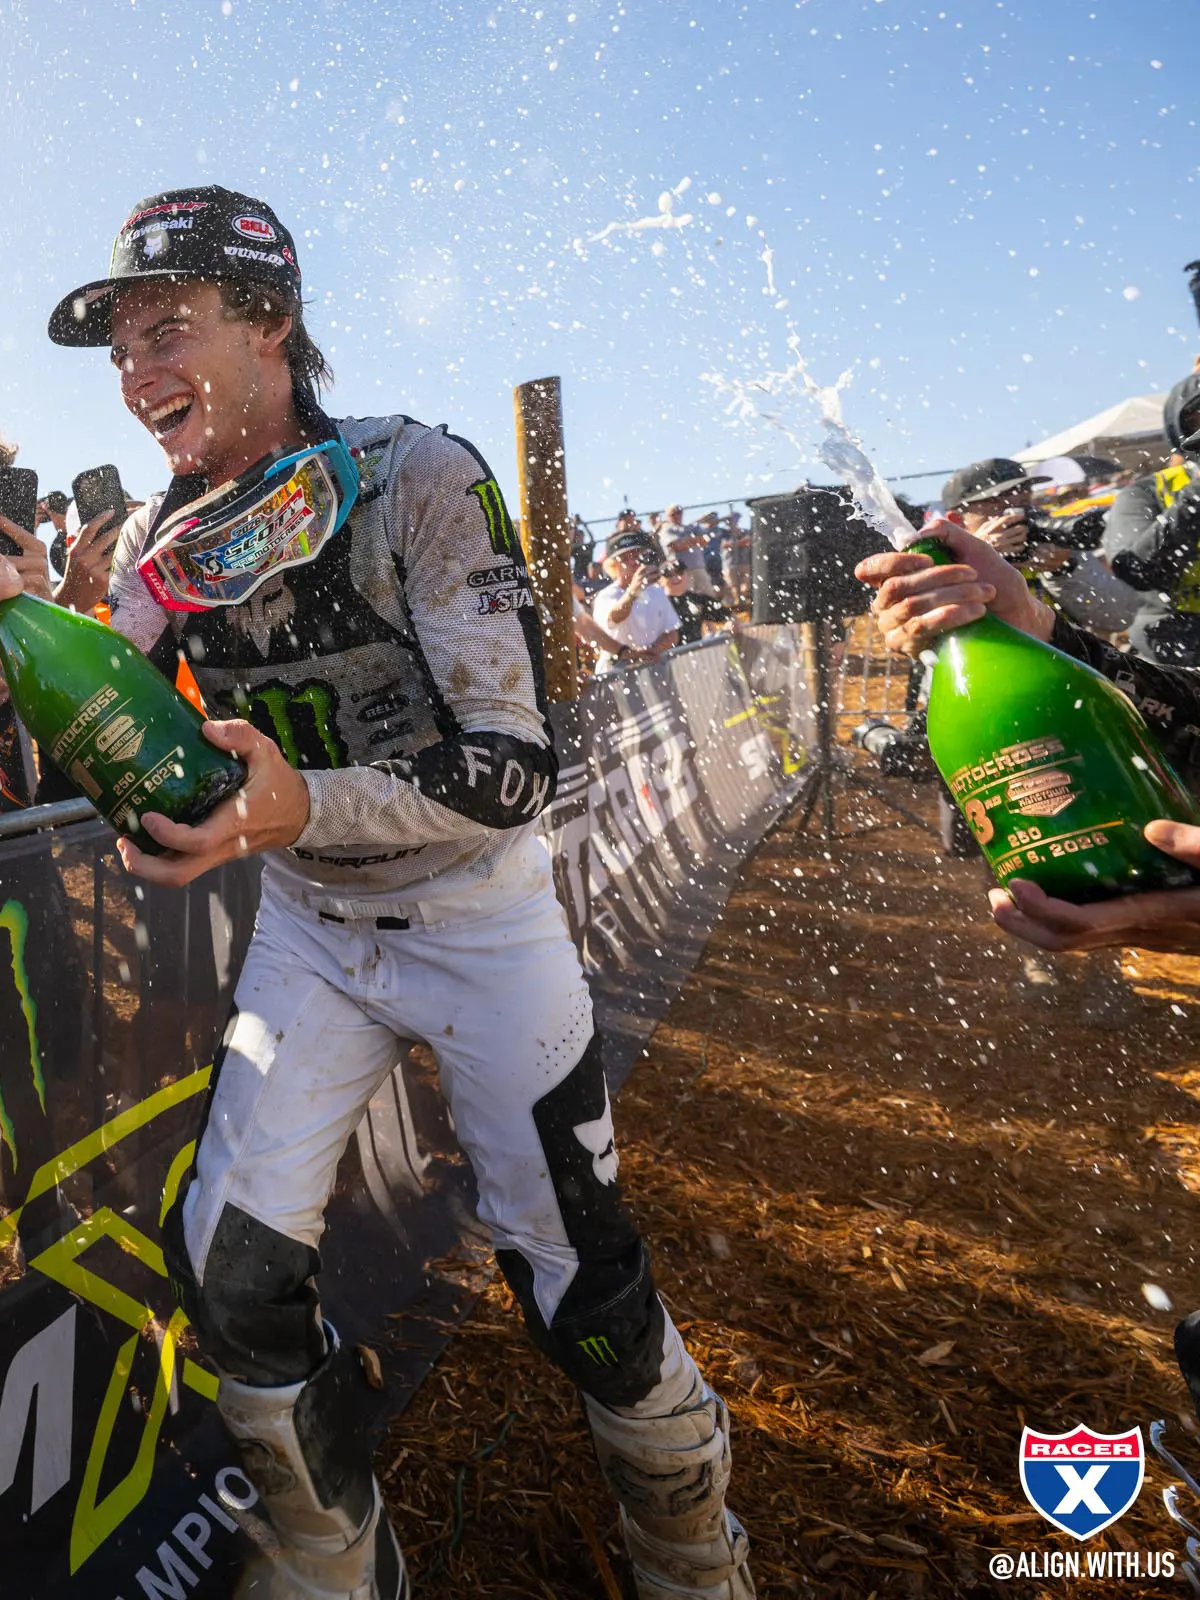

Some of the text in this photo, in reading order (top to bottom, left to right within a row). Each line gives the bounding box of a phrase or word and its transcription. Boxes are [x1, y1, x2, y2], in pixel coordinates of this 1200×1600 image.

[239, 218, 273, 237] BELL
[224, 246, 286, 266] DUNLOP
[225, 498, 298, 558] SCOTT
[234, 515, 261, 537] 2026
[113, 770, 137, 797] 250
[459, 744, 550, 818] FOX
[1007, 826, 1043, 848] 250
[1048, 830, 1110, 858] 2026
